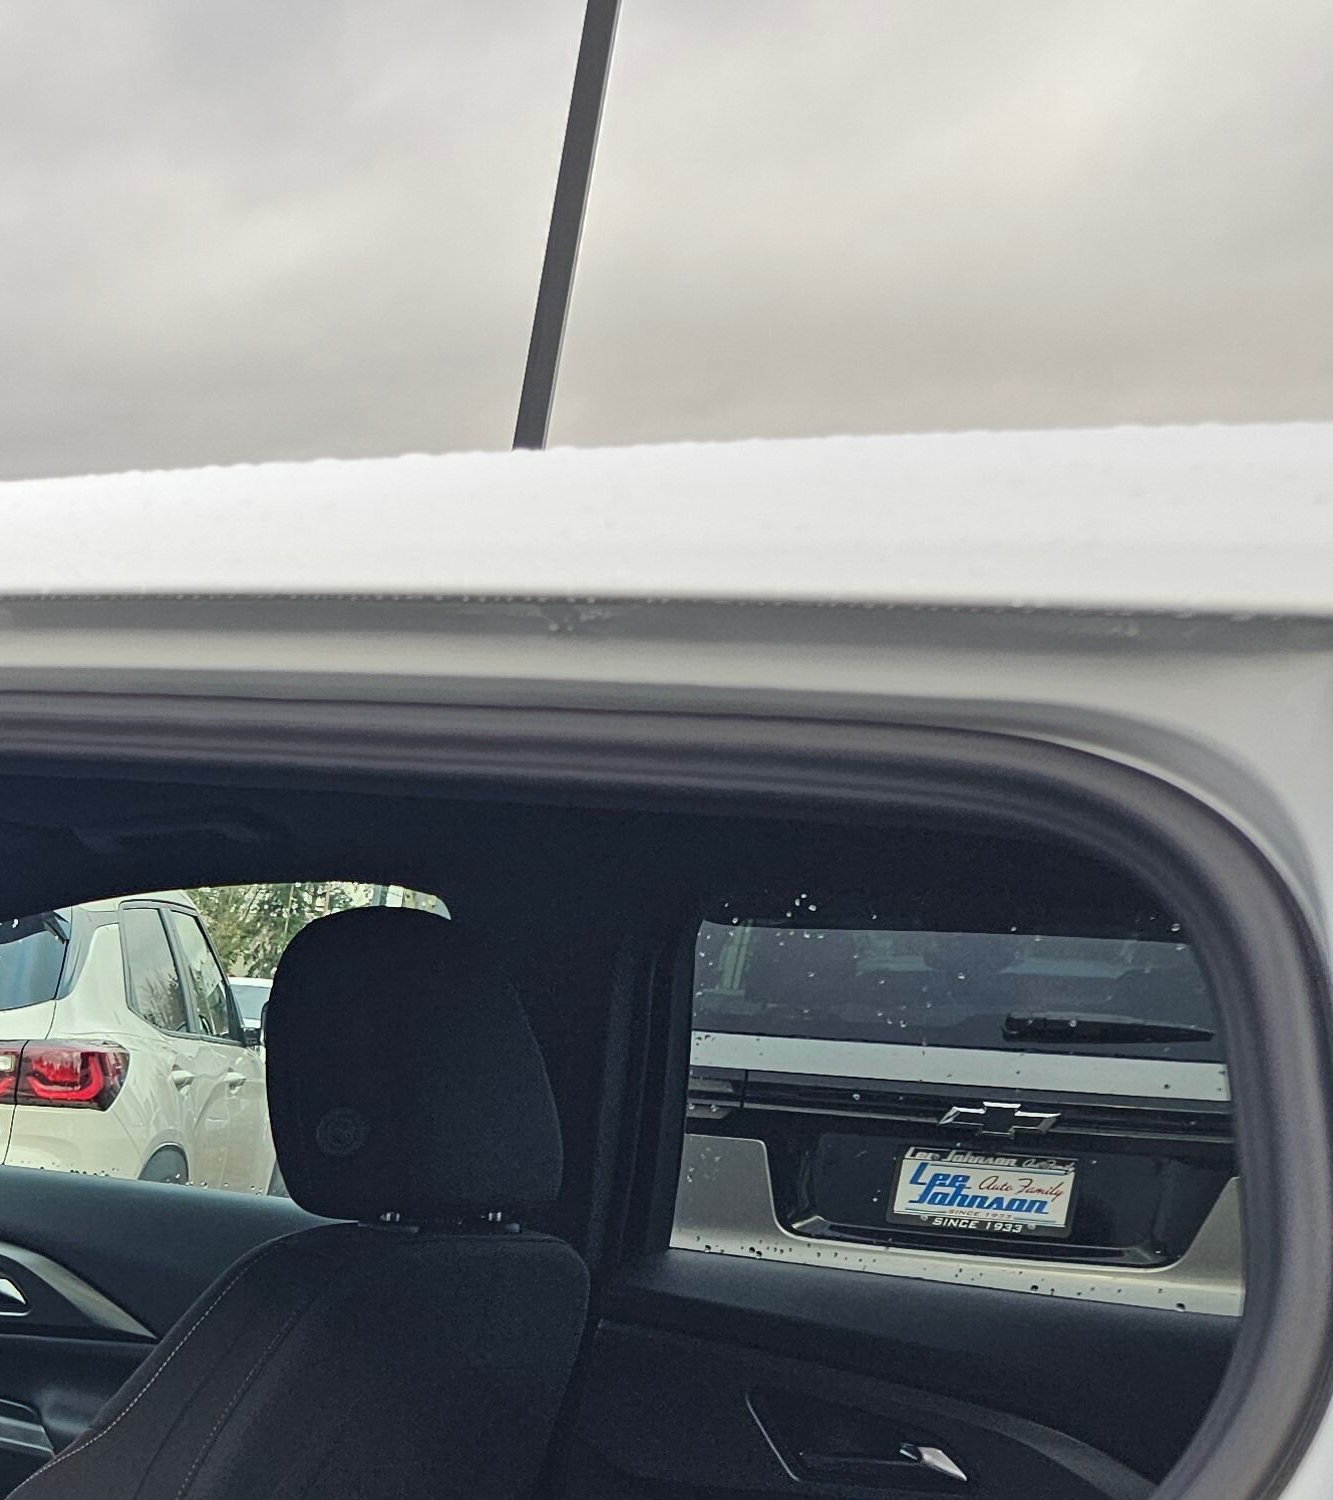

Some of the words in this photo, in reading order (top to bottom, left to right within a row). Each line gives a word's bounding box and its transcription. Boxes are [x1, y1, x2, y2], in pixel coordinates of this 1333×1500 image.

[941, 1150, 1017, 1168] Johnson
[909, 1162, 971, 1188] Lee
[909, 1184, 1049, 1215] Johnson
[978, 1175, 1013, 1192] Auto
[1014, 1178, 1064, 1202] Family
[932, 1217, 980, 1230] SINCE
[985, 1221, 1024, 1233] 1933
[948, 1209, 981, 1217] SINCE
[985, 1212, 1013, 1220] 1933
